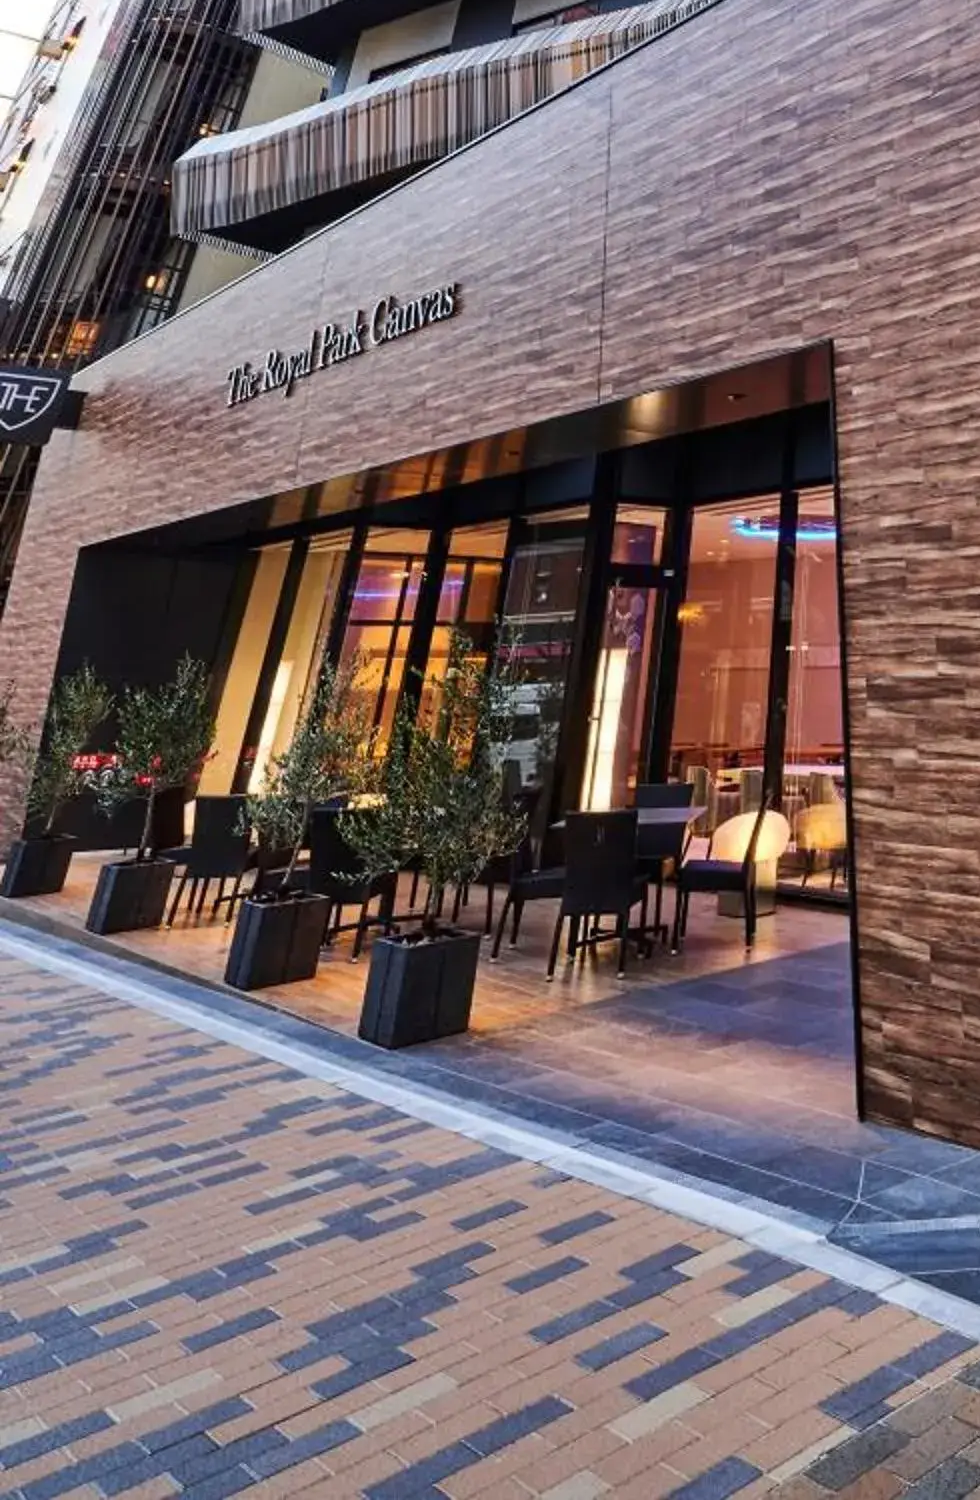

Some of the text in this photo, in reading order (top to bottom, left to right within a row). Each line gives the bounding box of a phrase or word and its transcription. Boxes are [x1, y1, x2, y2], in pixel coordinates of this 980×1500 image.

[227, 282, 463, 408] The Royal Park Canvas
